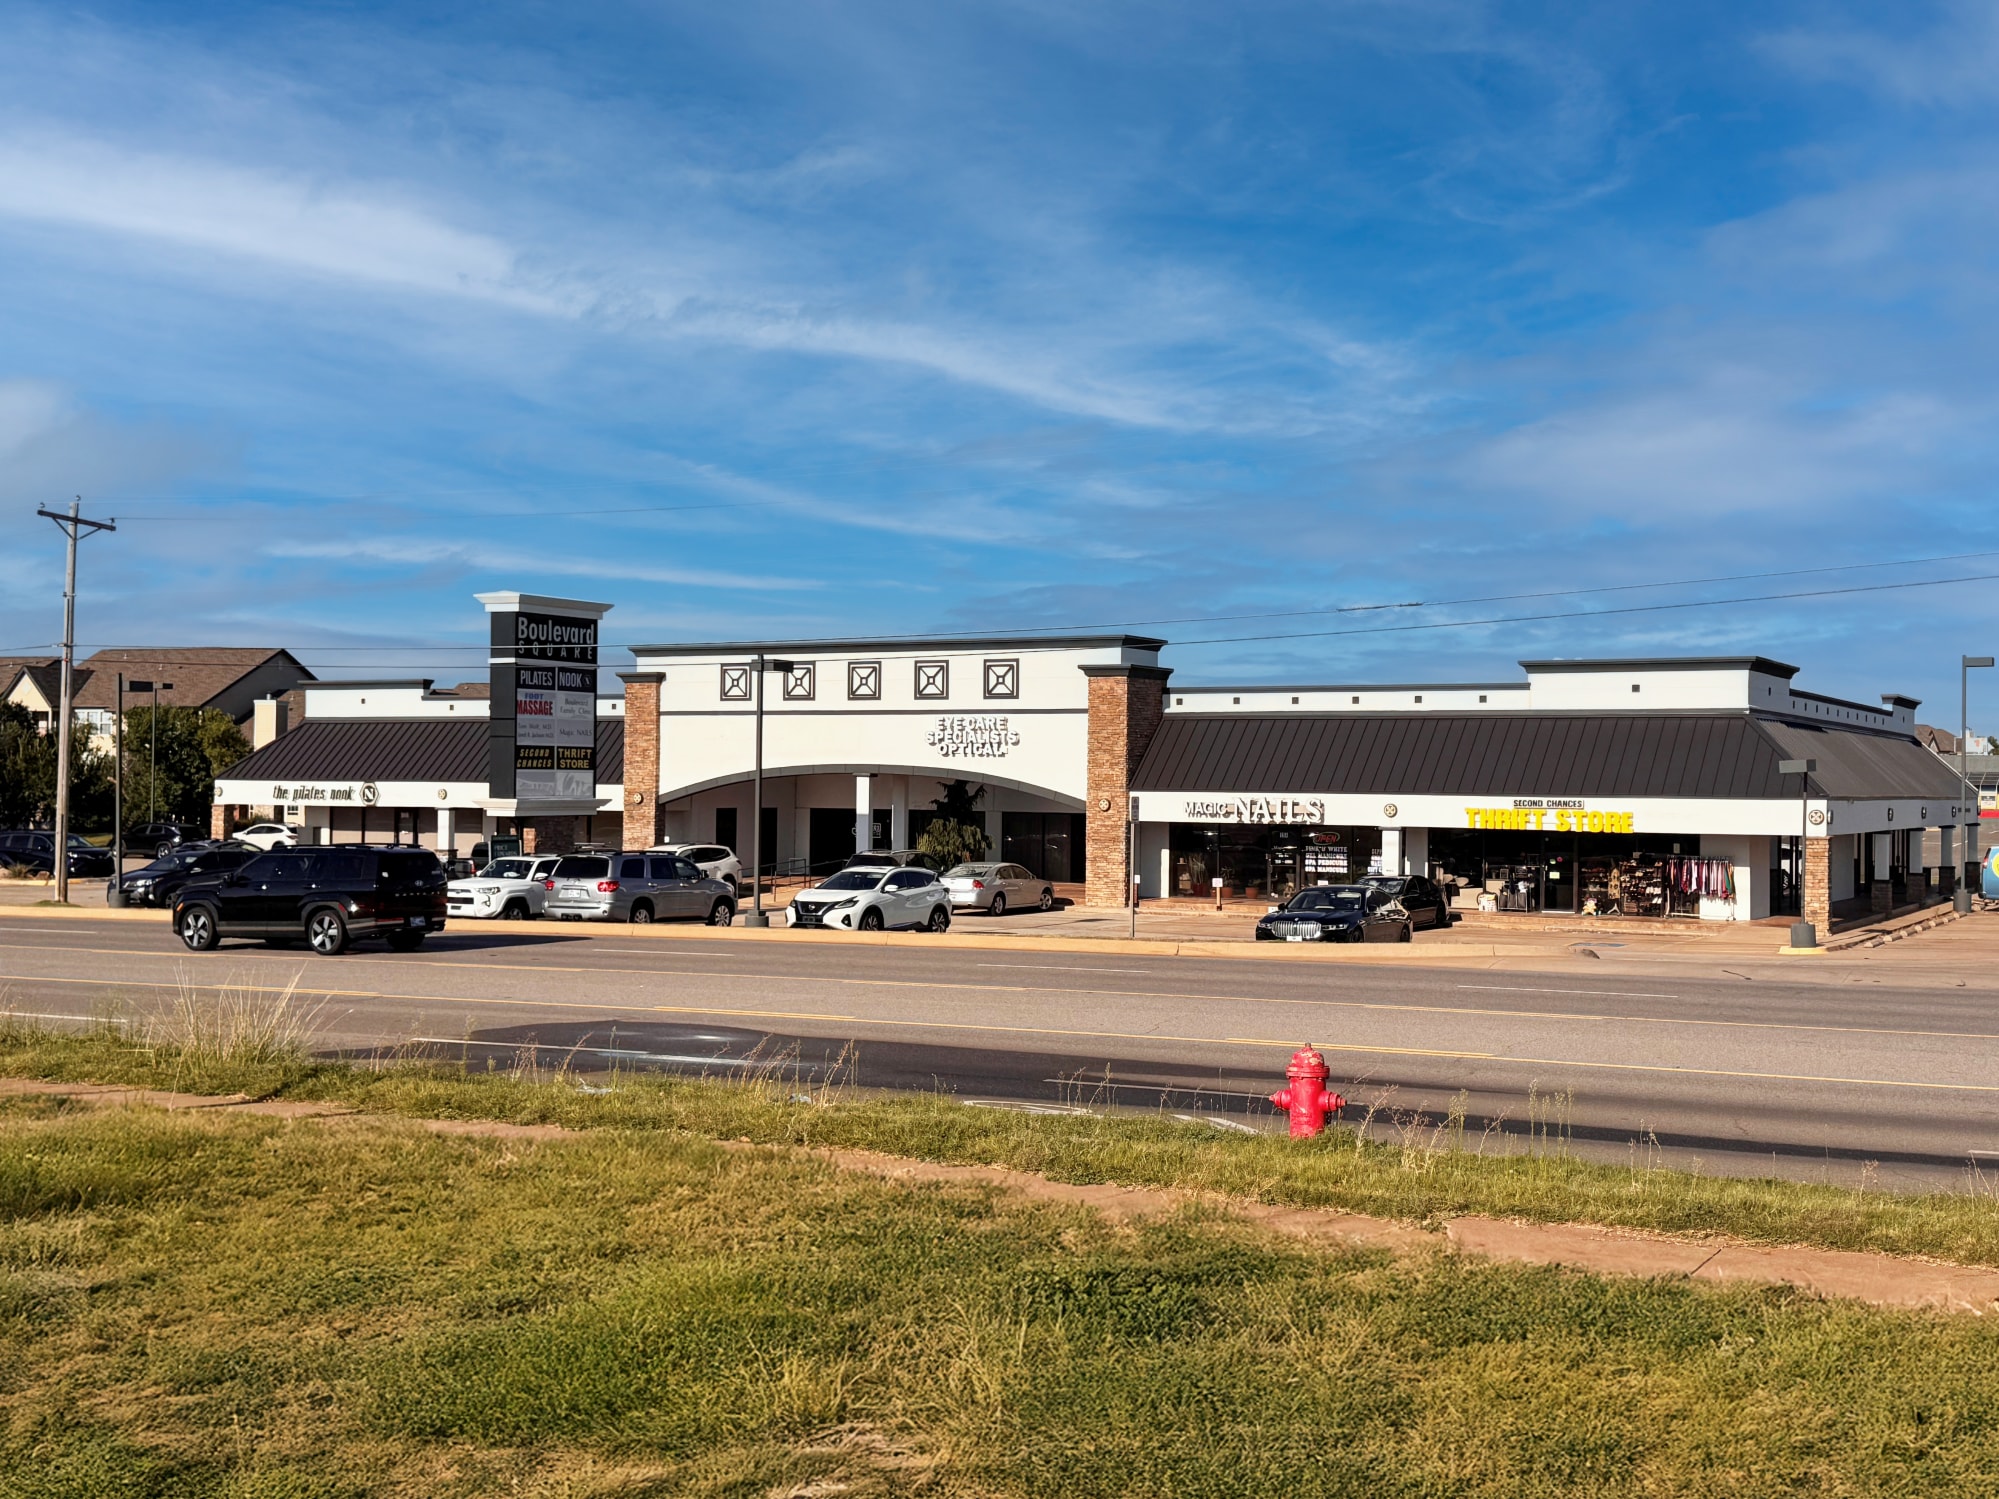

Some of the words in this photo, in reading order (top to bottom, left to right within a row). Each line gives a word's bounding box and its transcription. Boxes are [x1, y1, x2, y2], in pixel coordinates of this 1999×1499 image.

[517, 615, 594, 645] Boulevard
[518, 640, 593, 659] SQUARE
[520, 670, 553, 686] PILATES
[559, 672, 583, 687] NOOK
[524, 692, 544, 700] FOOT
[516, 700, 553, 716] MASSAGE
[926, 730, 1020, 746] SPECIALISTS
[520, 748, 550, 757] SECOND
[558, 748, 592, 758] THRIFT
[938, 743, 1008, 757] OPTICAL
[516, 759, 552, 768] CHANCES
[560, 760, 590, 769] STORE
[272, 785, 289, 799] the
[292, 785, 326, 802] pilates
[330, 786, 355, 800] nook
[1184, 801, 1231, 818] MAGIC
[1233, 797, 1325, 824] NAILS
[1513, 799, 1544, 808] SECOND
[1546, 800, 1583, 808] CHANCES
[1465, 807, 1547, 831] THRIFT
[1555, 809, 1635, 834] STORE
